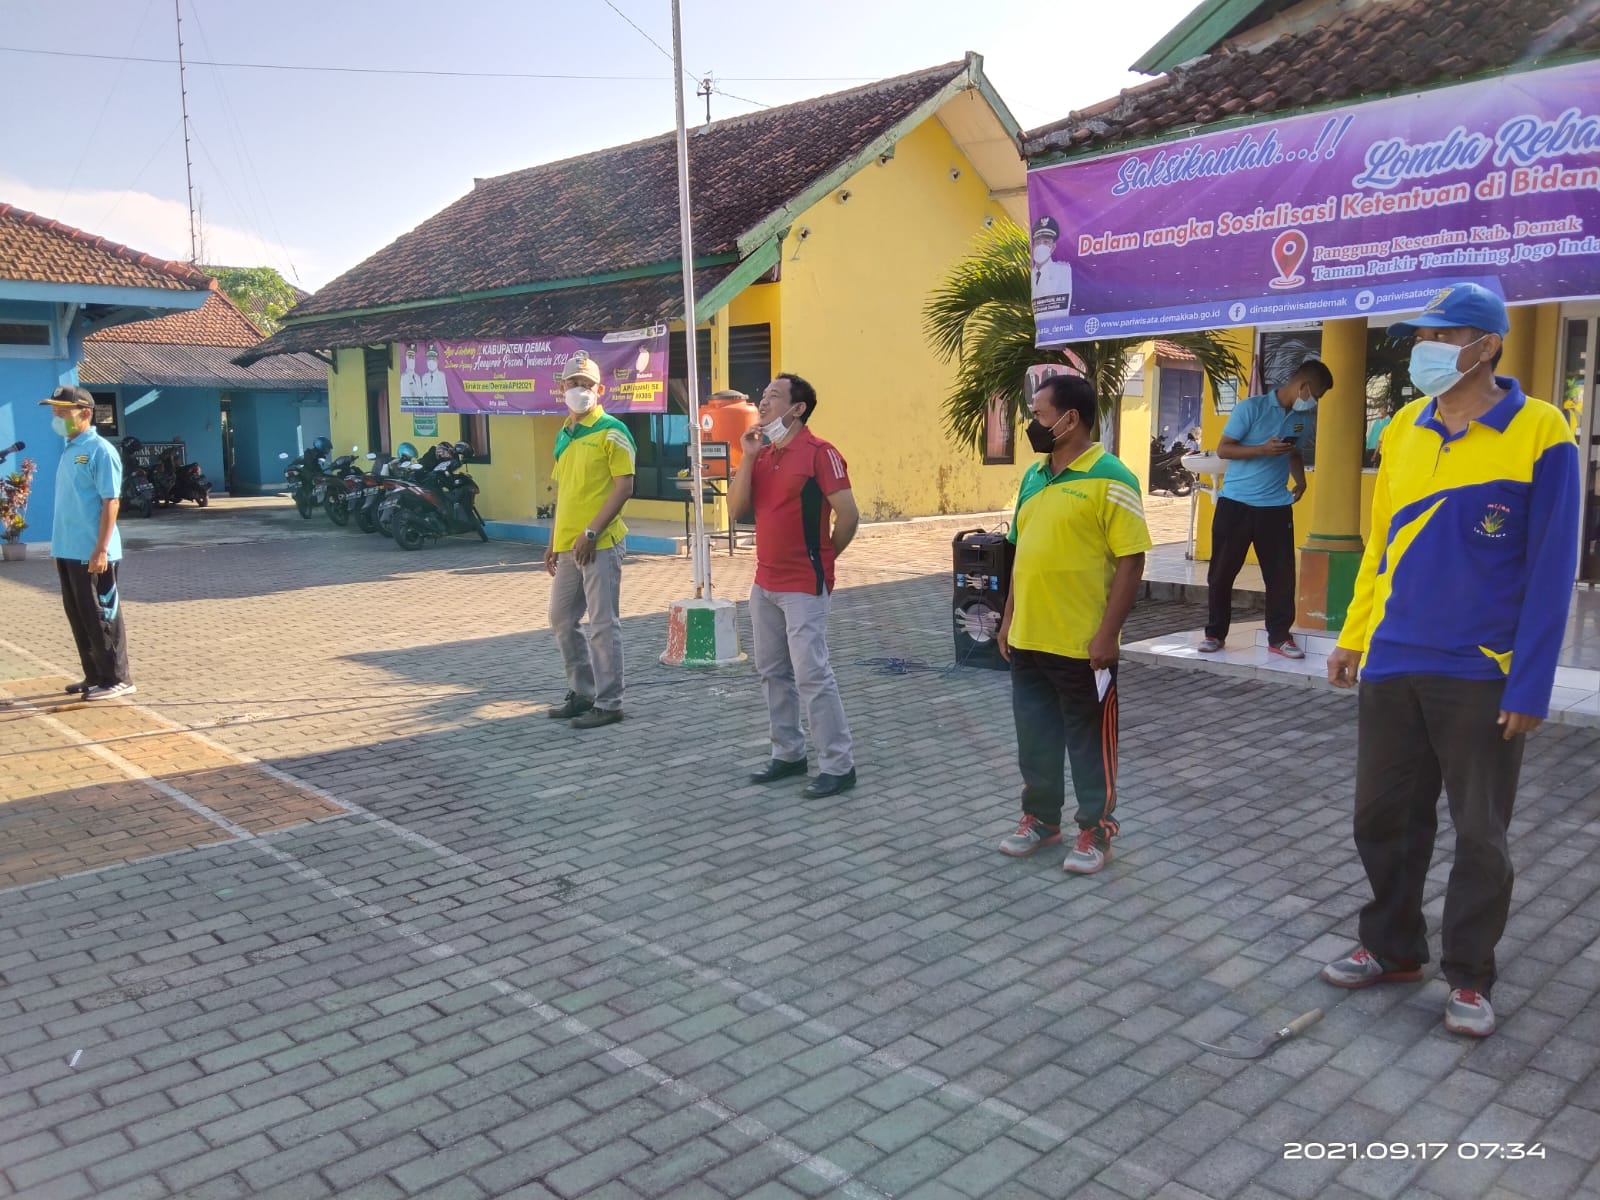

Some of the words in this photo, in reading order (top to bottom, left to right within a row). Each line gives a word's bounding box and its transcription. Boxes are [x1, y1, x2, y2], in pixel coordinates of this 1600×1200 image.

[1353, 126, 1492, 187] Lomba
[1494, 108, 1600, 166] Reba
[1079, 232, 1139, 255] Dalam
[1143, 218, 1214, 247] rangka
[1217, 198, 1338, 236] Sosialisasi
[1341, 182, 1470, 219] Ketentuan
[1476, 172, 1505, 200] di
[1511, 165, 1600, 197] Bidan
[1312, 262, 1364, 281] Taman
[1367, 257, 1418, 275] Parkir
[1420, 246, 1509, 269] Tembiring
[1512, 242, 1555, 262] Jogo
[1560, 236, 1600, 255] Inda
[1313, 241, 1389, 261] Panggung
[1391, 230, 1466, 253] Kesenian
[1470, 224, 1510, 242] Kab.
[1514, 215, 1582, 238] Demak
[1249, 297, 1348, 314] dinaspariwisatademak
[483, 343, 524, 354] KABUPATEN
[525, 341, 551, 352] DEMAK
